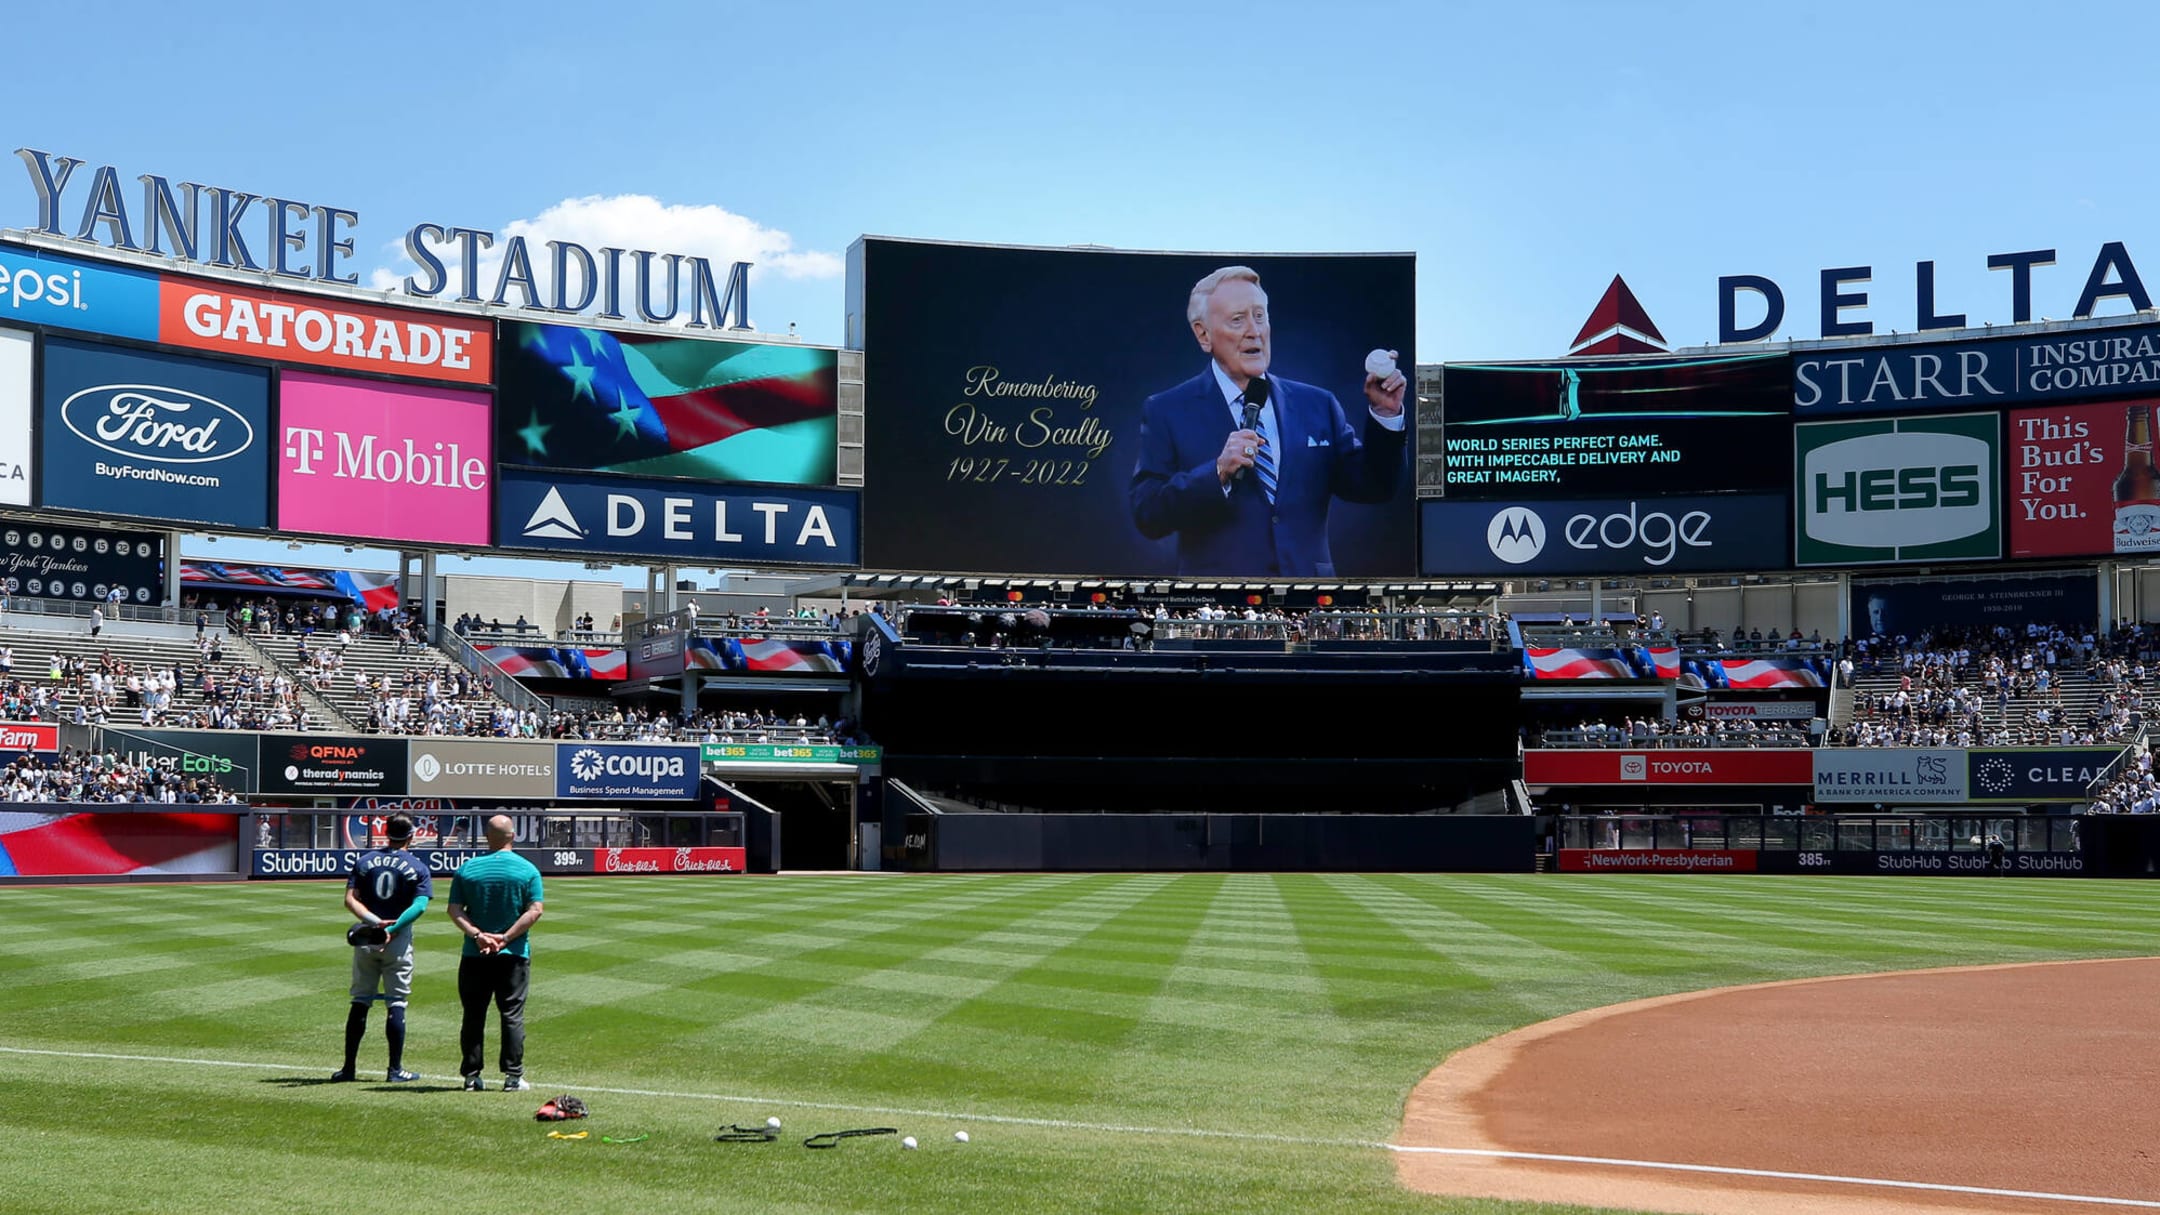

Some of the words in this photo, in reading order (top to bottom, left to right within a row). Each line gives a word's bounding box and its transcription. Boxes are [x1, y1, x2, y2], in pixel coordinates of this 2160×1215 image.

[14, 147, 359, 284] YANKEE
[403, 223, 754, 331] STADIUM
[1719, 241, 2154, 344] DELTA
[183, 294, 471, 370] GATORADE
[2030, 335, 2160, 367] INSURA
[964, 365, 1099, 409] Remembering
[1794, 351, 2003, 406] STARR
[96, 392, 222, 454] Ford
[945, 403, 1008, 445] Vin
[1015, 408, 1113, 458] Scully
[2019, 415, 2089, 441] This
[1447, 438, 1498, 451] WORLD
[1502, 437, 1550, 450] SERIES
[1553, 436, 1615, 449] PERFECT
[1619, 434, 1663, 448] GAME.
[334, 432, 487, 490] Mobile
[1447, 454, 1484, 467] WITH
[1488, 452, 1575, 466] IMPECCABLE
[1579, 451, 1647, 465] DELIVERY
[1651, 450, 1680, 463] AND
[2020, 441, 2104, 468] Bud's
[95, 462, 219, 487] BuyFordNow.com
[947, 457, 1089, 485] 1927-2022
[1447, 470, 1492, 483] GREAT
[1495, 469, 1561, 484] IMAGERY,
[1815, 464, 1980, 513] HESS
[2020, 472, 2074, 495] For
[2020, 498, 2087, 521] You.
[607, 494, 837, 548] DELTA
[7, 533, 18, 543] 37
[32, 535, 38, 544] 8
[55, 538, 61, 546] 8
[1565, 502, 1712, 566] edge
[75, 540, 84, 549] 16
[97, 542, 106, 551] 15
[117, 544, 128, 552] 32
[141, 546, 147, 554] 9
[9, 553, 39, 573] York
[40, 555, 89, 576] Yankees
[29, 582, 40, 591] 42
[54, 584, 60, 592] 6
[75, 586, 84, 595] 51
[140, 591, 146, 599] 2
[1707, 705, 1757, 715] TOYOTA
[1759, 704, 1813, 714] TERRACE
[0, 728, 38, 746] Farm
[310, 745, 358, 758] QFNA
[706, 746, 745, 756] bet365
[774, 746, 812, 757] bet365
[840, 748, 877, 759] bet365
[128, 751, 178, 771] Uber
[183, 753, 233, 772] Eats
[445, 763, 496, 775] LOTTE
[499, 764, 552, 776] HOTELS
[606, 755, 684, 782] coupa
[1651, 762, 1713, 774] TOYOTA
[303, 768, 385, 781] theradynamics
[1817, 772, 1911, 784] MERRILL
[569, 785, 604, 794] Business
[605, 785, 630, 796] Spend
[632, 786, 685, 796] Management
[1817, 788, 1824, 796] A
[1826, 788, 1851, 796] BANK
[1854, 788, 1865, 796] OF
[1868, 788, 1911, 796] AMERICA
[1913, 788, 1961, 796] COMPANY
[262, 852, 337, 872] StubHub
[429, 852, 475, 870] Stub
[1878, 855, 1942, 869] StubHub
[2018, 856, 2083, 870] StubHub
[375, 871, 394, 900] 0
